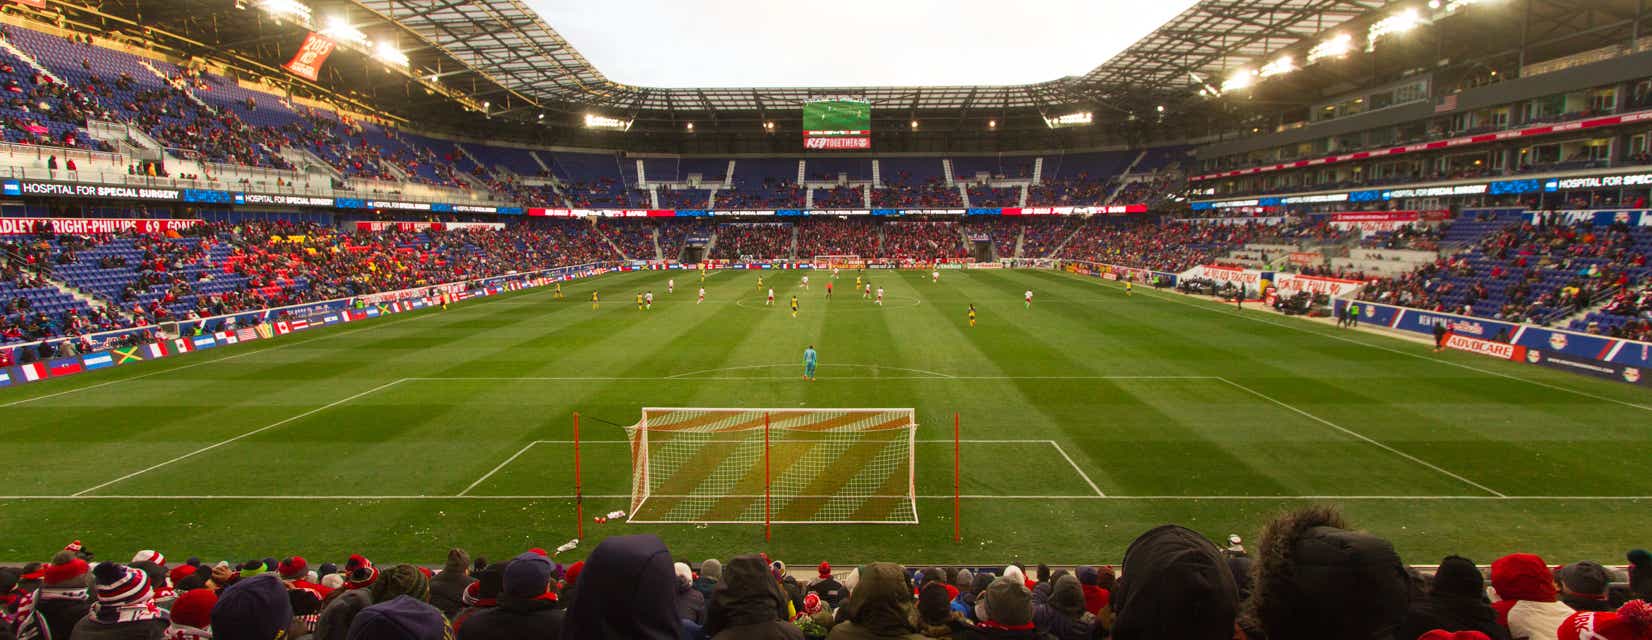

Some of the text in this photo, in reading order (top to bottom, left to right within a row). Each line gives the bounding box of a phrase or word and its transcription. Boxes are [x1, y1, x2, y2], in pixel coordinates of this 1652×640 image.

[1559, 178, 1601, 189] HOSPITAL
[1602, 176, 1622, 186] FOR
[22, 183, 75, 195] HOSPITAL
[76, 185, 96, 195] FOR
[97, 187, 138, 198] SPECIAL
[139, 189, 179, 199] SURGERY
[145, 221, 160, 233] 69
[1450, 336, 1512, 357] ADVOCARE
